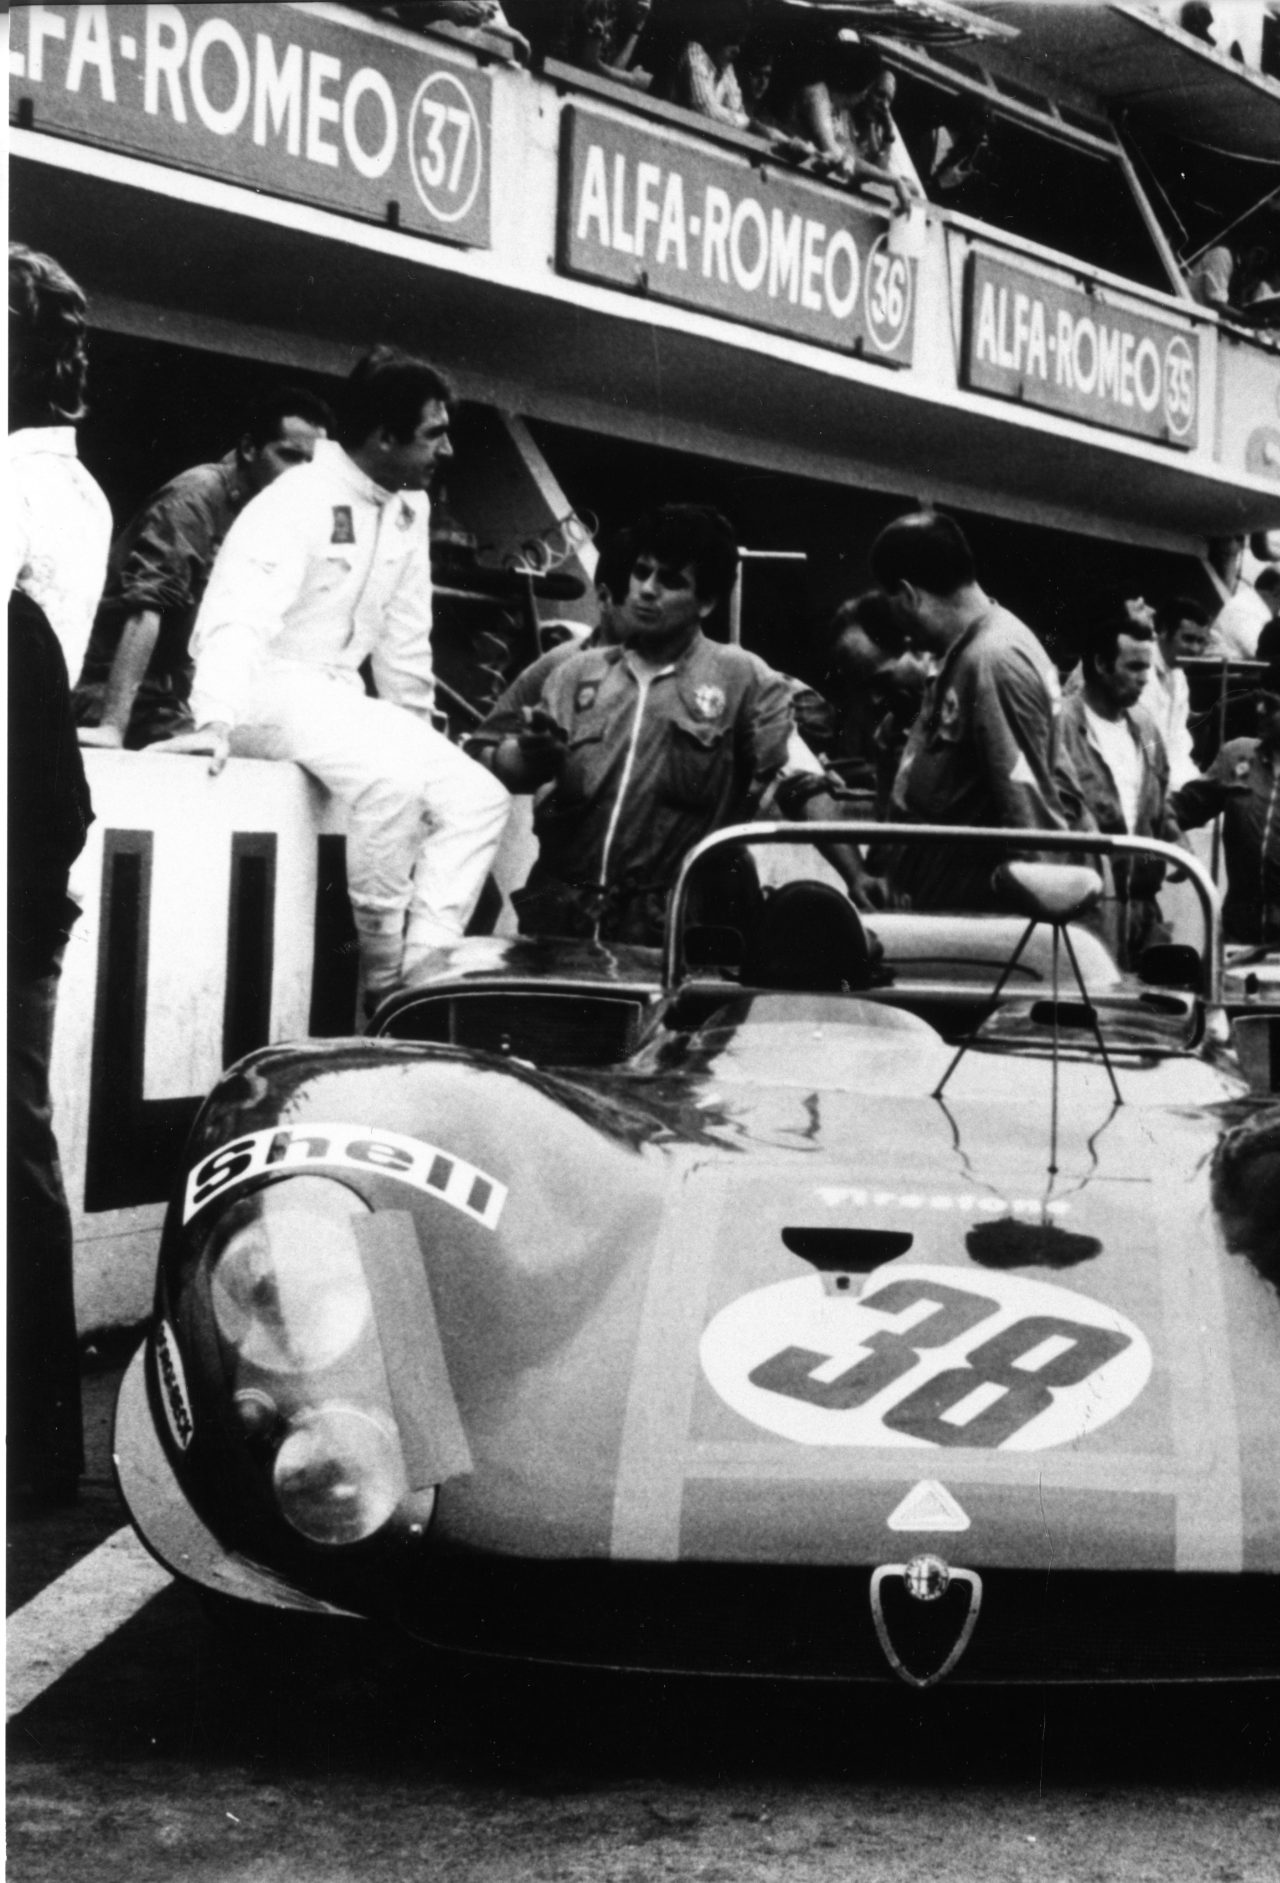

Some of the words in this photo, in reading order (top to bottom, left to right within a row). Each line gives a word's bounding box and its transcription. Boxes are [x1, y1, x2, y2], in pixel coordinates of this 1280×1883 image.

[9, 6, 398, 178] FA-ROMEO
[420, 99, 471, 192] 37
[577, 145, 860, 319] ALFA-ROMEO
[870, 253, 904, 328] 36
[976, 282, 1161, 412] ALFA-ROMEO
[1165, 352, 1194, 416] 35
[192, 1131, 494, 1217] Shell
[747, 1278, 1133, 1448] 38
